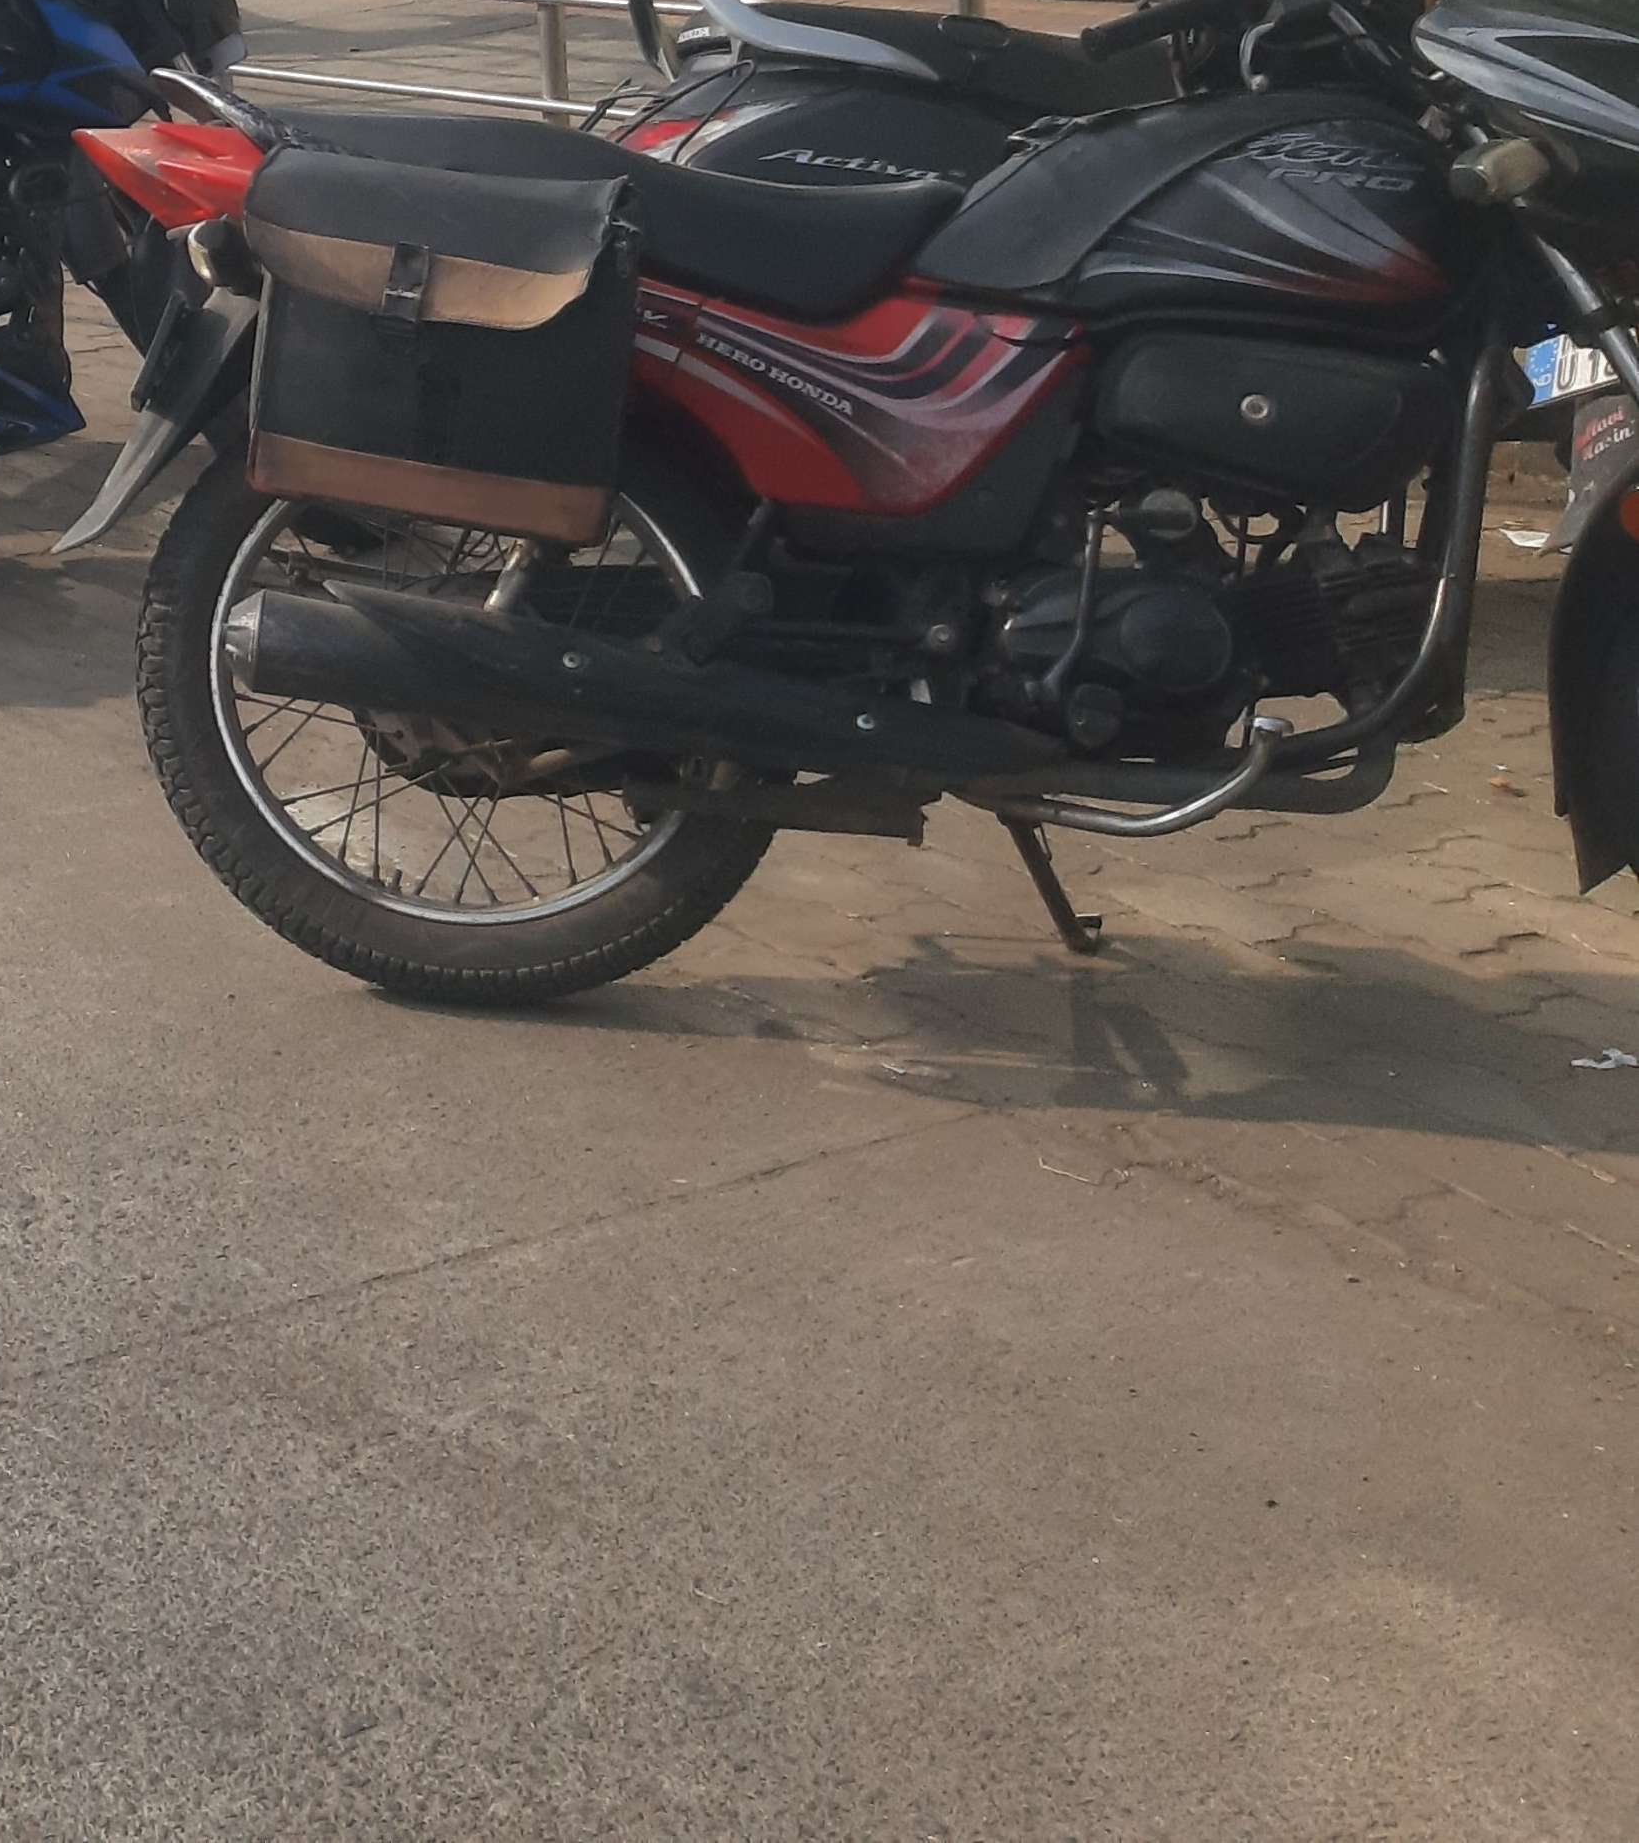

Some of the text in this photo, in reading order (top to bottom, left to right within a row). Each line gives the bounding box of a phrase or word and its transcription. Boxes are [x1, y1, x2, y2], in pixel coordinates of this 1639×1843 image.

[758, 149, 939, 180] Activa
[696, 332, 853, 416] HERO HONDA
